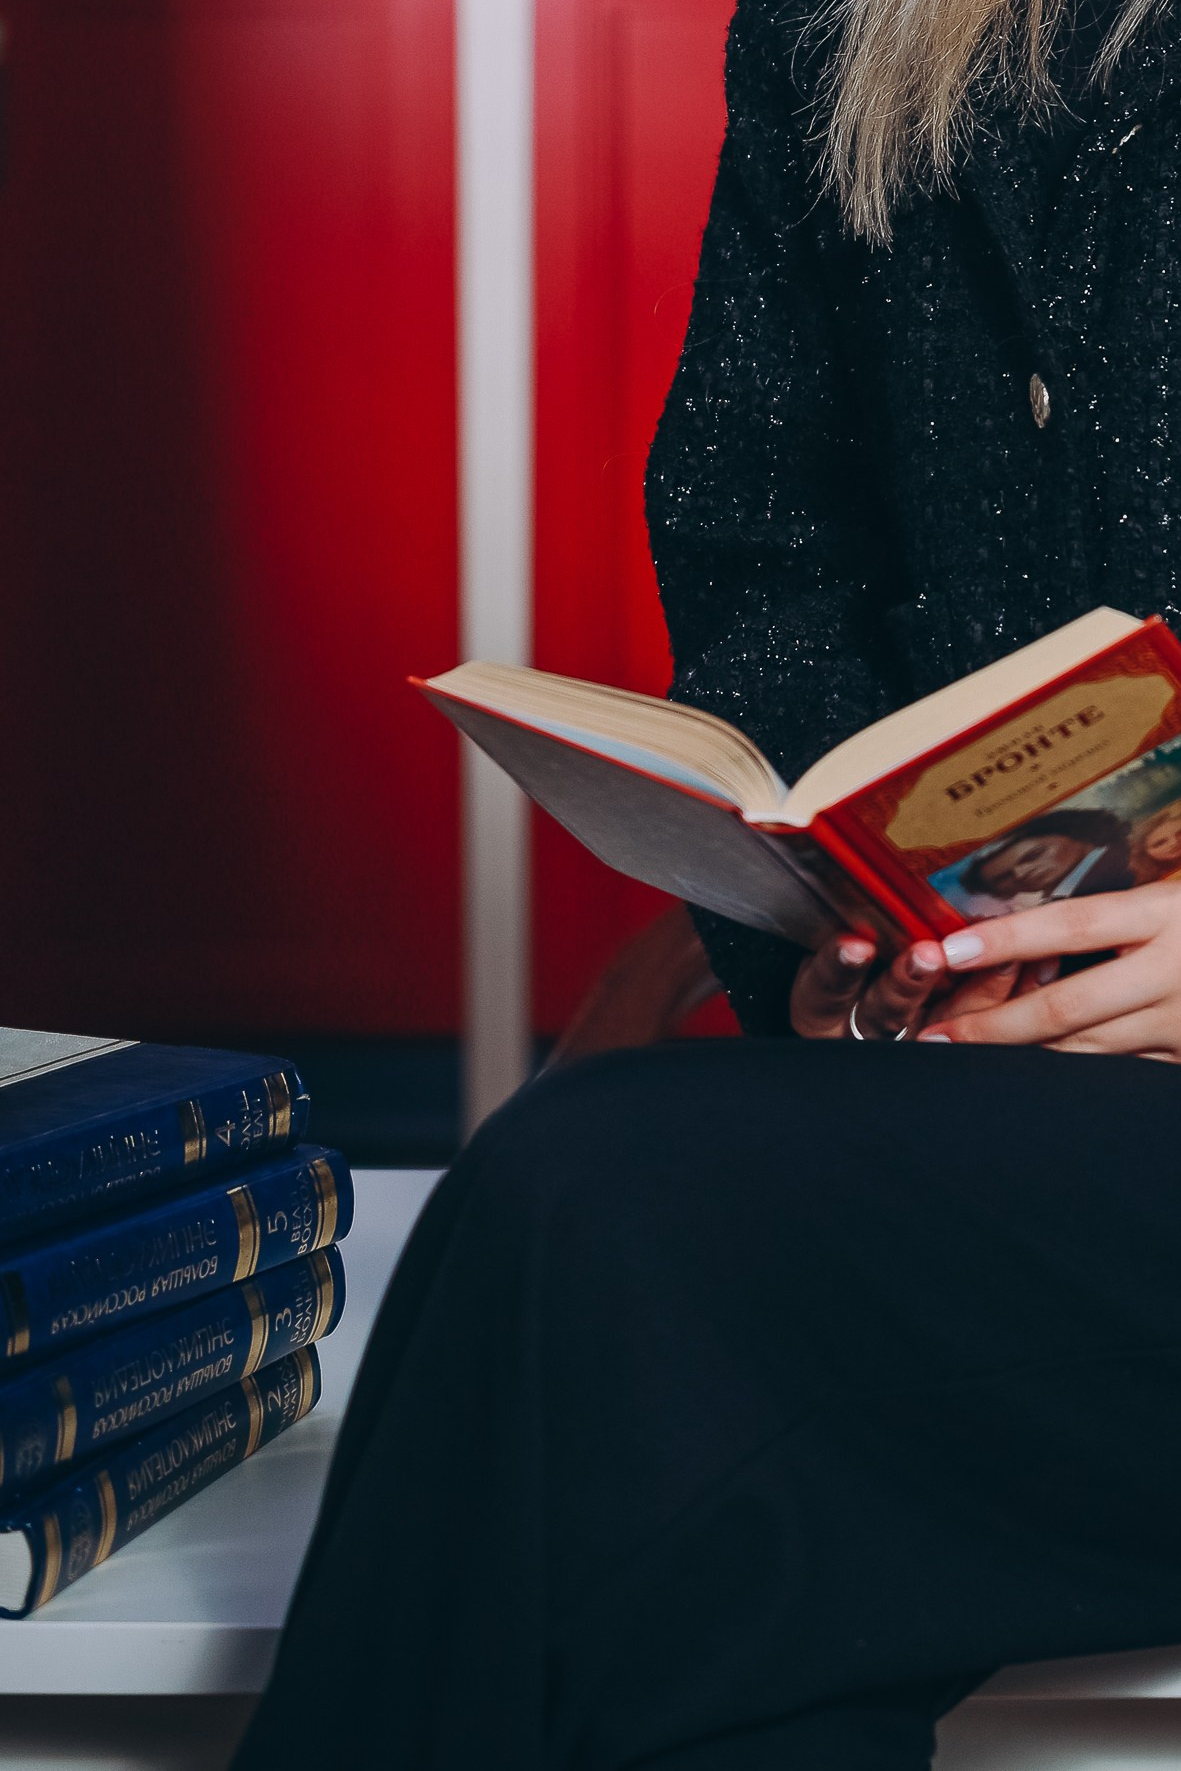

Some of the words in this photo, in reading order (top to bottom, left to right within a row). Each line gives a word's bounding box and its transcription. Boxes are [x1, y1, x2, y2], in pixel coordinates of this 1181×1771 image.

[944, 704, 1105, 803] БРОНТЕ
[215, 1119, 236, 1147] 4
[267, 1210, 288, 1235] 5
[151, 1254, 219, 1298] БОЛЬШАЯ
[51, 1281, 147, 1335] РОССИЙСКАЯ
[275, 1307, 292, 1332] 3
[92, 1317, 235, 1409] ЭНЦИКЛОПЕДИЯ
[175, 1353, 234, 1398] БОЛЬШАЯ
[92, 1382, 174, 1440] РОССИЙСКАЯ
[267, 1384, 282, 1413] 2
[126, 1400, 237, 1501] ЭНЦИКЛОПЕДИЯ
